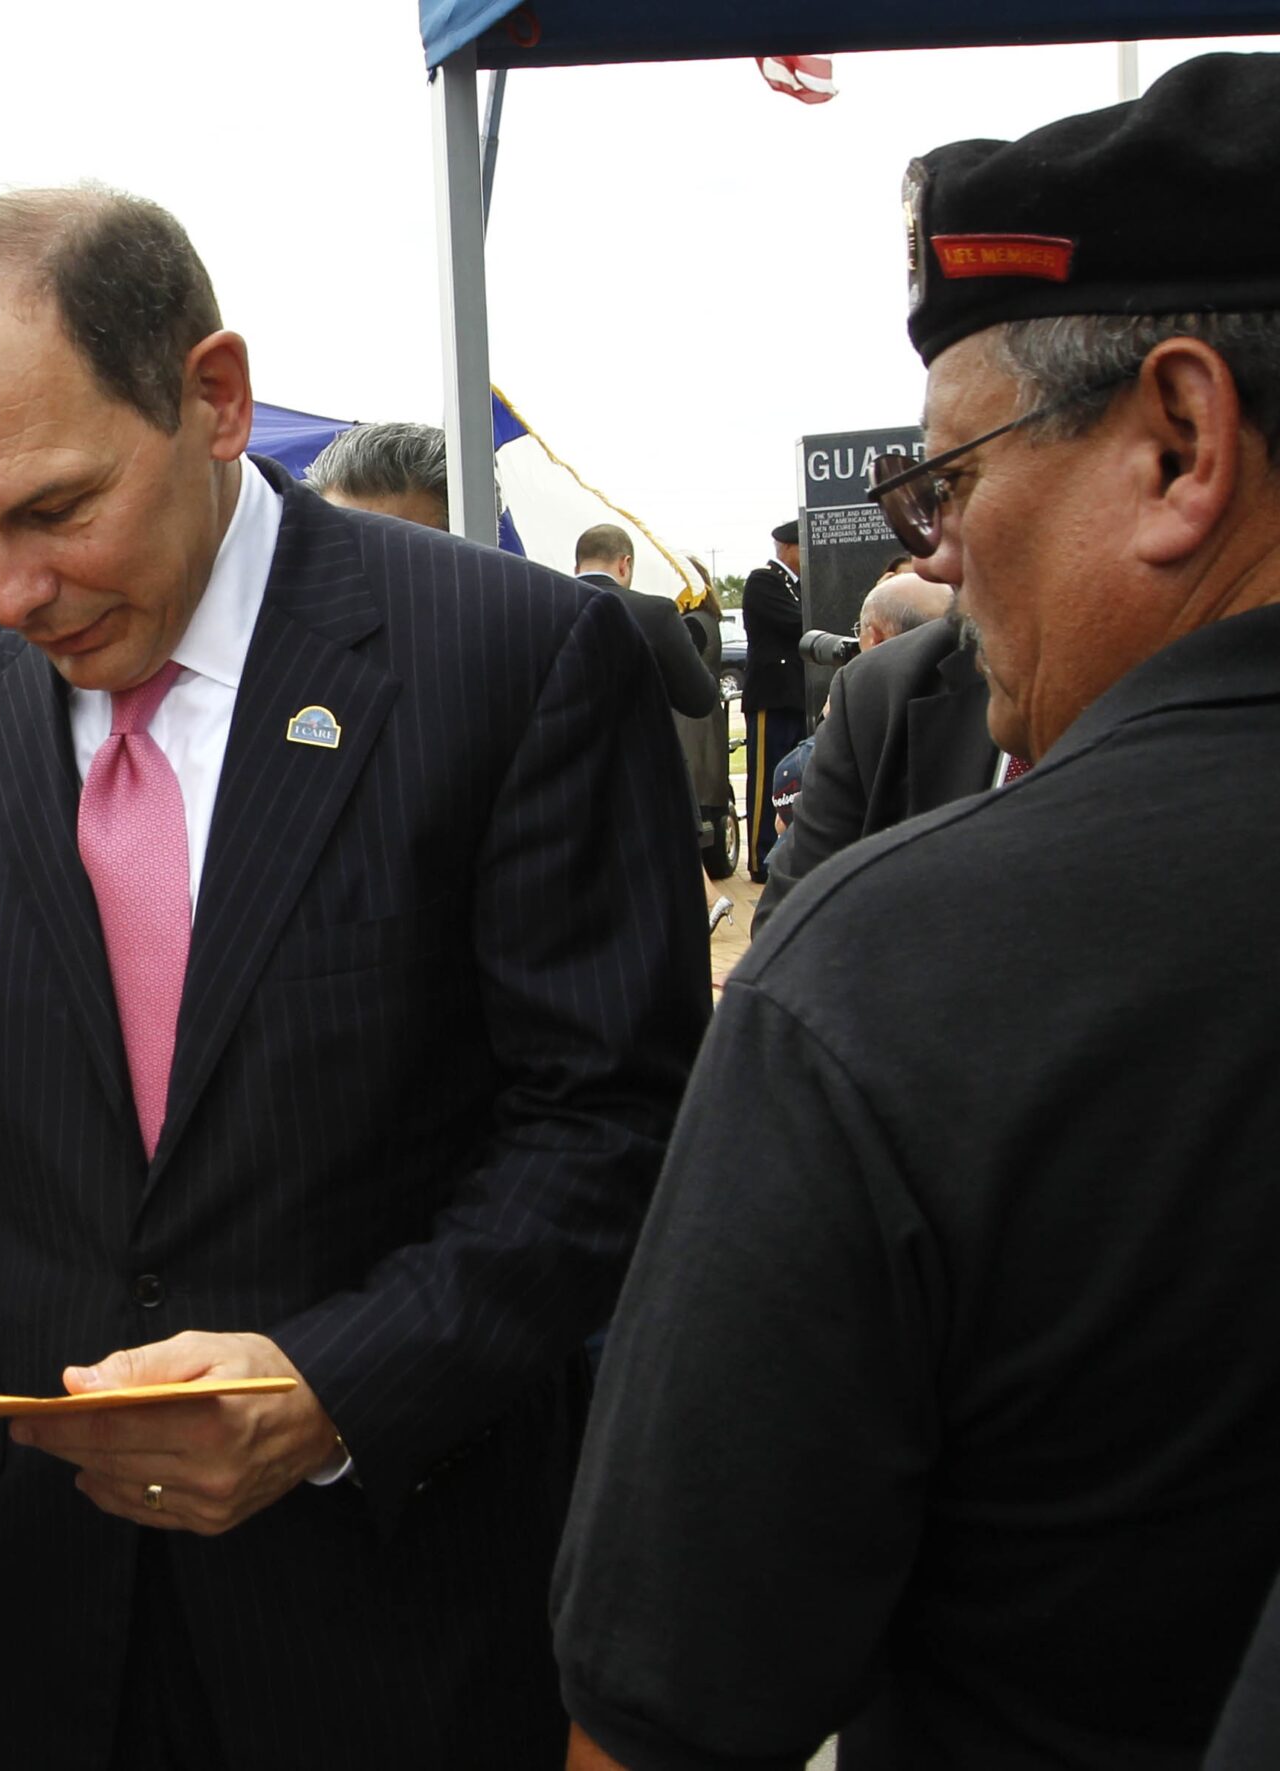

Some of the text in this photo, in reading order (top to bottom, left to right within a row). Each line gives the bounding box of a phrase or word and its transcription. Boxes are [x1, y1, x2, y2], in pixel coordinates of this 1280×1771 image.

[944, 247, 978, 264] LIFE
[814, 512, 825, 520] THE
[302, 727, 333, 739] CARE
